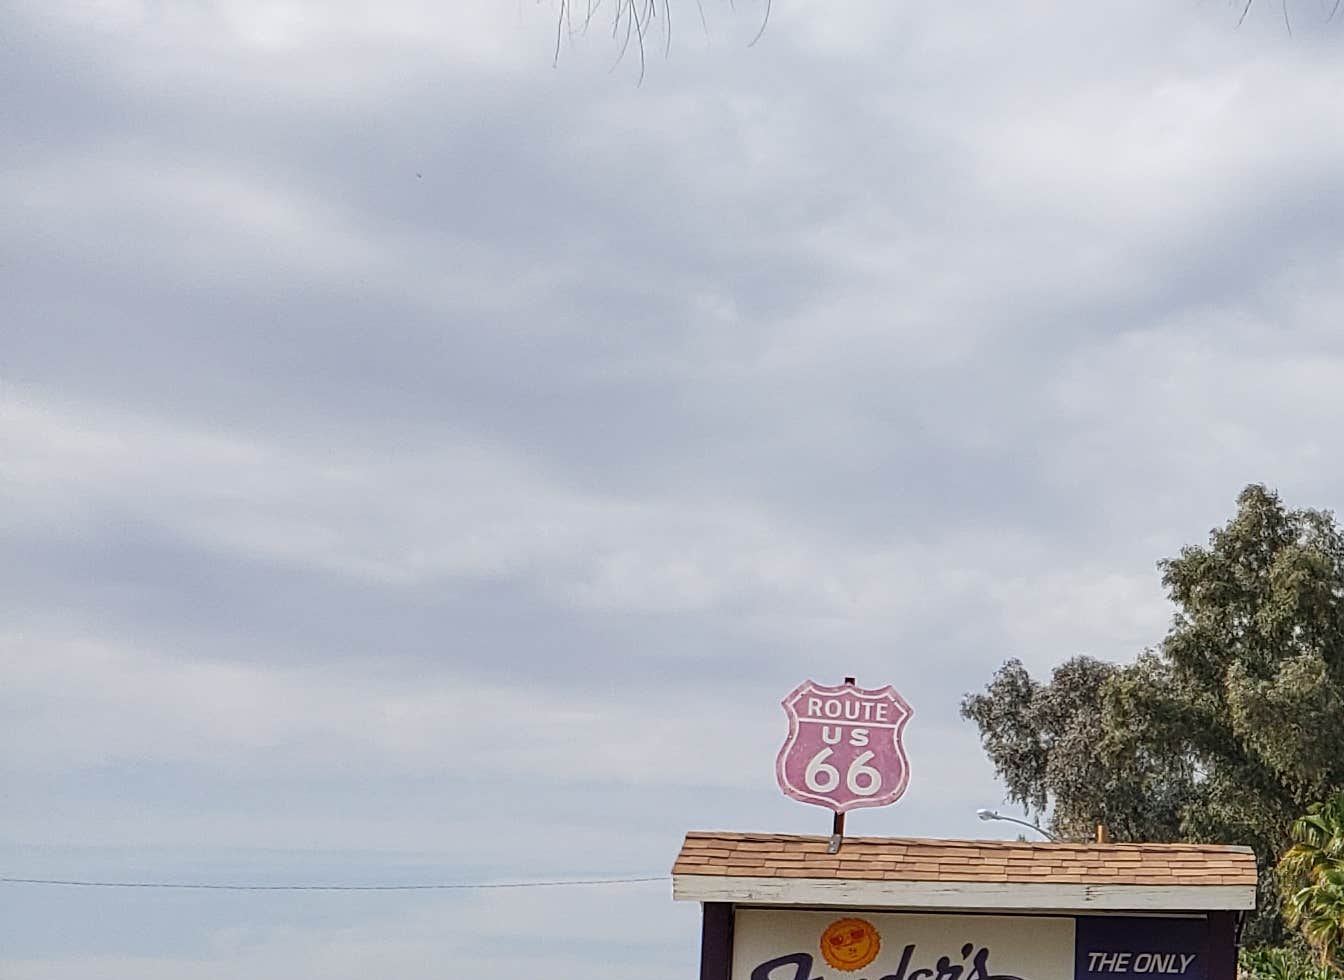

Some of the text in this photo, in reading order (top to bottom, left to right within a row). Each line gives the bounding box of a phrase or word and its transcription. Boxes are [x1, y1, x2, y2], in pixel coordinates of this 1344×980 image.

[808, 697, 889, 721] ROUTE
[805, 747, 882, 796] 66
[1088, 952, 1196, 974] THE ONLY
